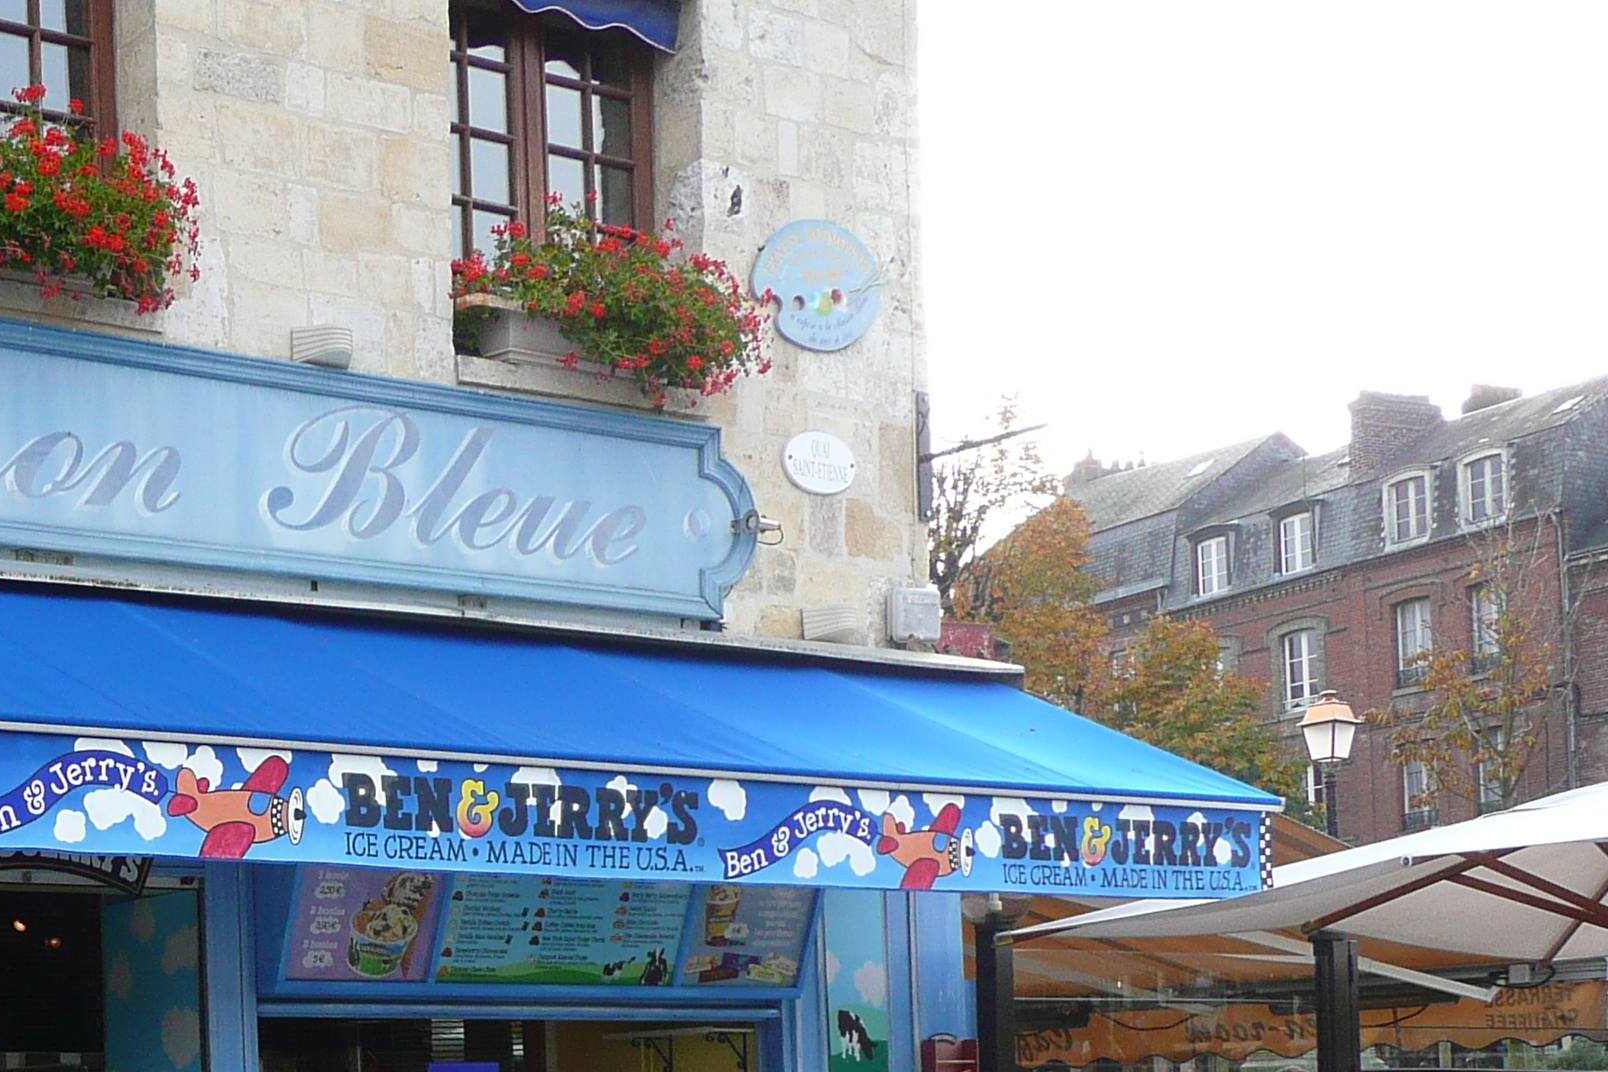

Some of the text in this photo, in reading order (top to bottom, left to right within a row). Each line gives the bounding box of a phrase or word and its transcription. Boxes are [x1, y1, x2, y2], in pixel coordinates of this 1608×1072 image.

[811, 439, 830, 459] QUAI
[260, 405, 648, 567] Bleue
[22, 782, 47, 816] &
[342, 772, 700, 847] BEN & JERRY'S
[344, 832, 379, 858] ICE
[384, 834, 468, 862] CREAM
[486, 838, 552, 867] MADE
[554, 842, 579, 868] IN
[585, 845, 631, 870] THE
[726, 846, 768, 879] Ben
[771, 825, 791, 856] &
[999, 813, 1252, 869] BEN & JERRY'S
[1003, 863, 1027, 885] ICE
[1030, 865, 1087, 888] CREAM
[1100, 867, 1149, 890] MADE
[1152, 869, 1168, 890] IN
[1172, 870, 1205, 891] THE
